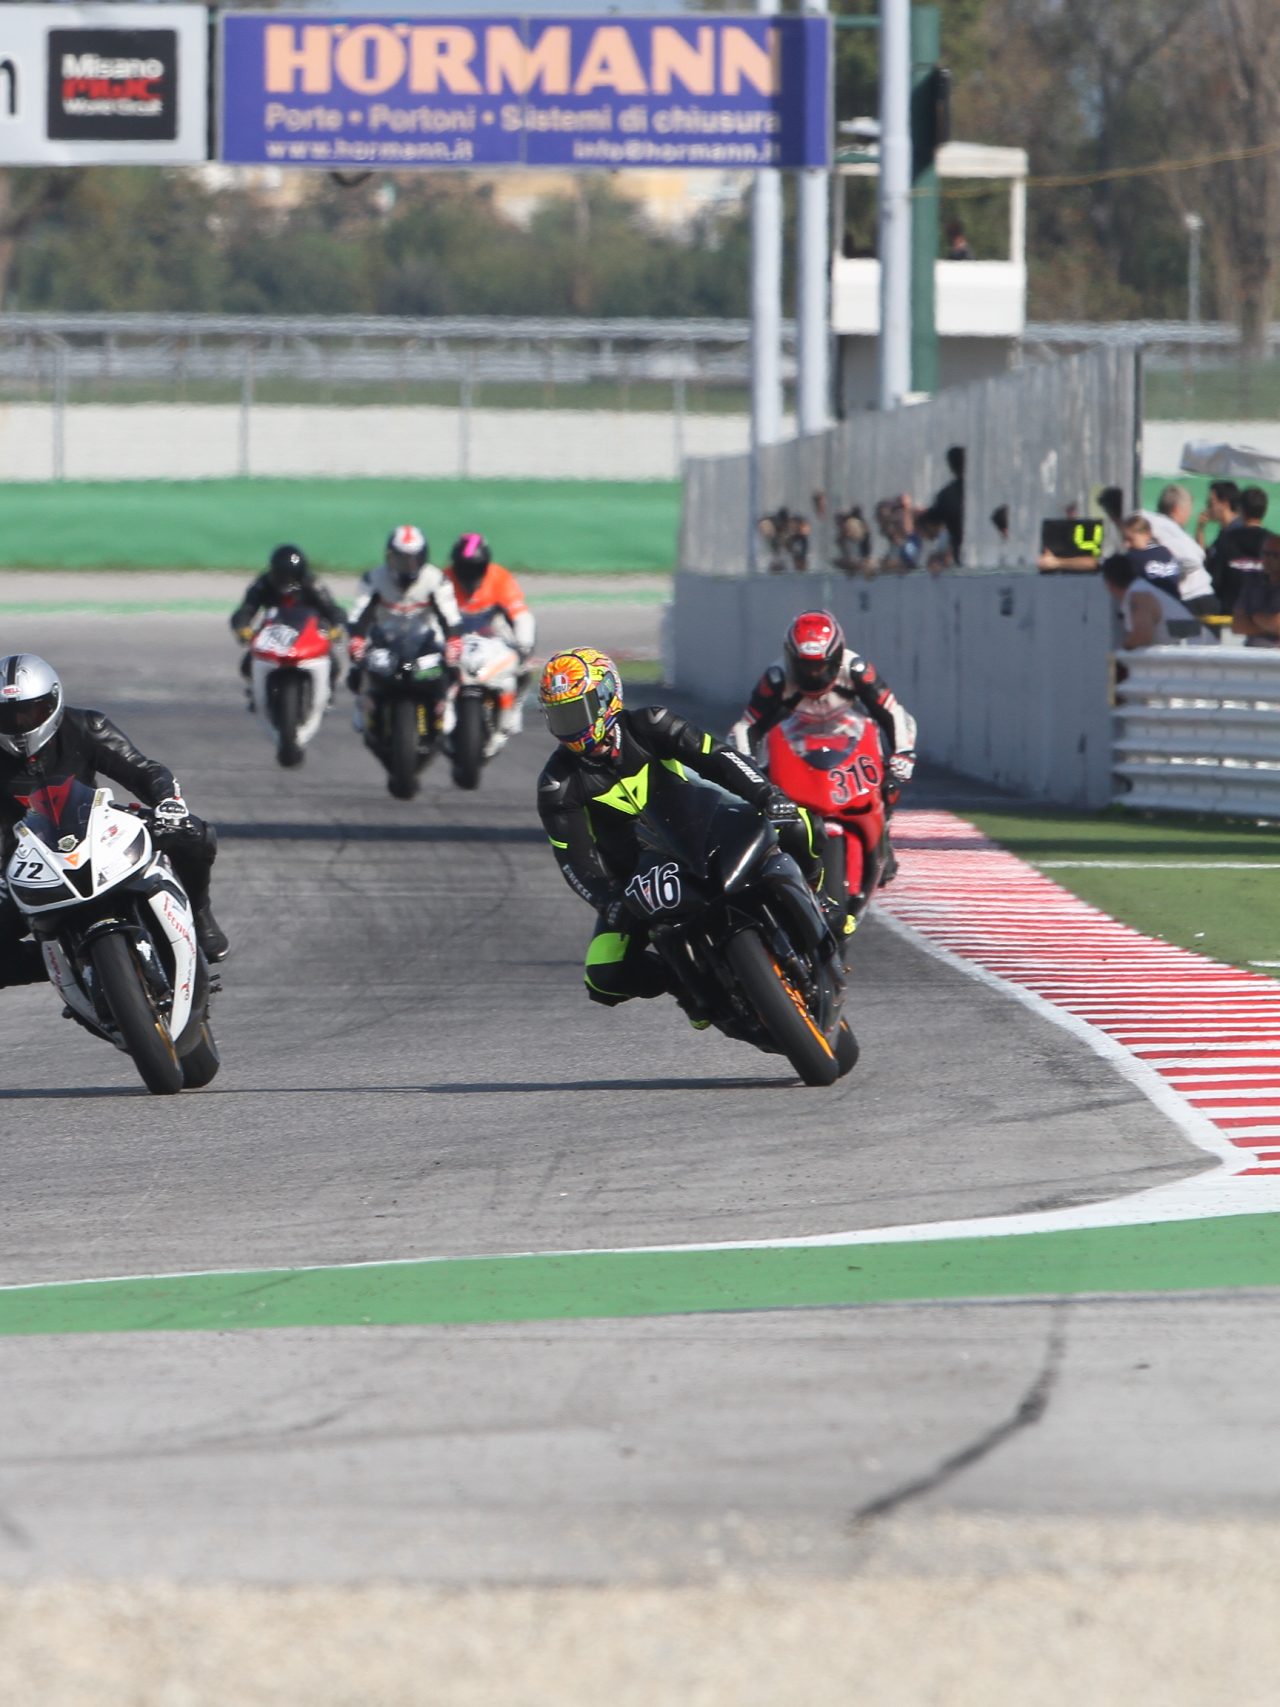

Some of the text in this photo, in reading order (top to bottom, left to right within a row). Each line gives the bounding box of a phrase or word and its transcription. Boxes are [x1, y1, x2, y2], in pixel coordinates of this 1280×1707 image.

[265, 21, 780, 96] HÖRMANN
[265, 103, 780, 133] Porte Portoni Sistemi di chiusura
[265, 138, 474, 161] www.hormann.it
[1074, 524, 1103, 558] 4
[828, 755, 881, 805] 316
[13, 861, 44, 880] 72
